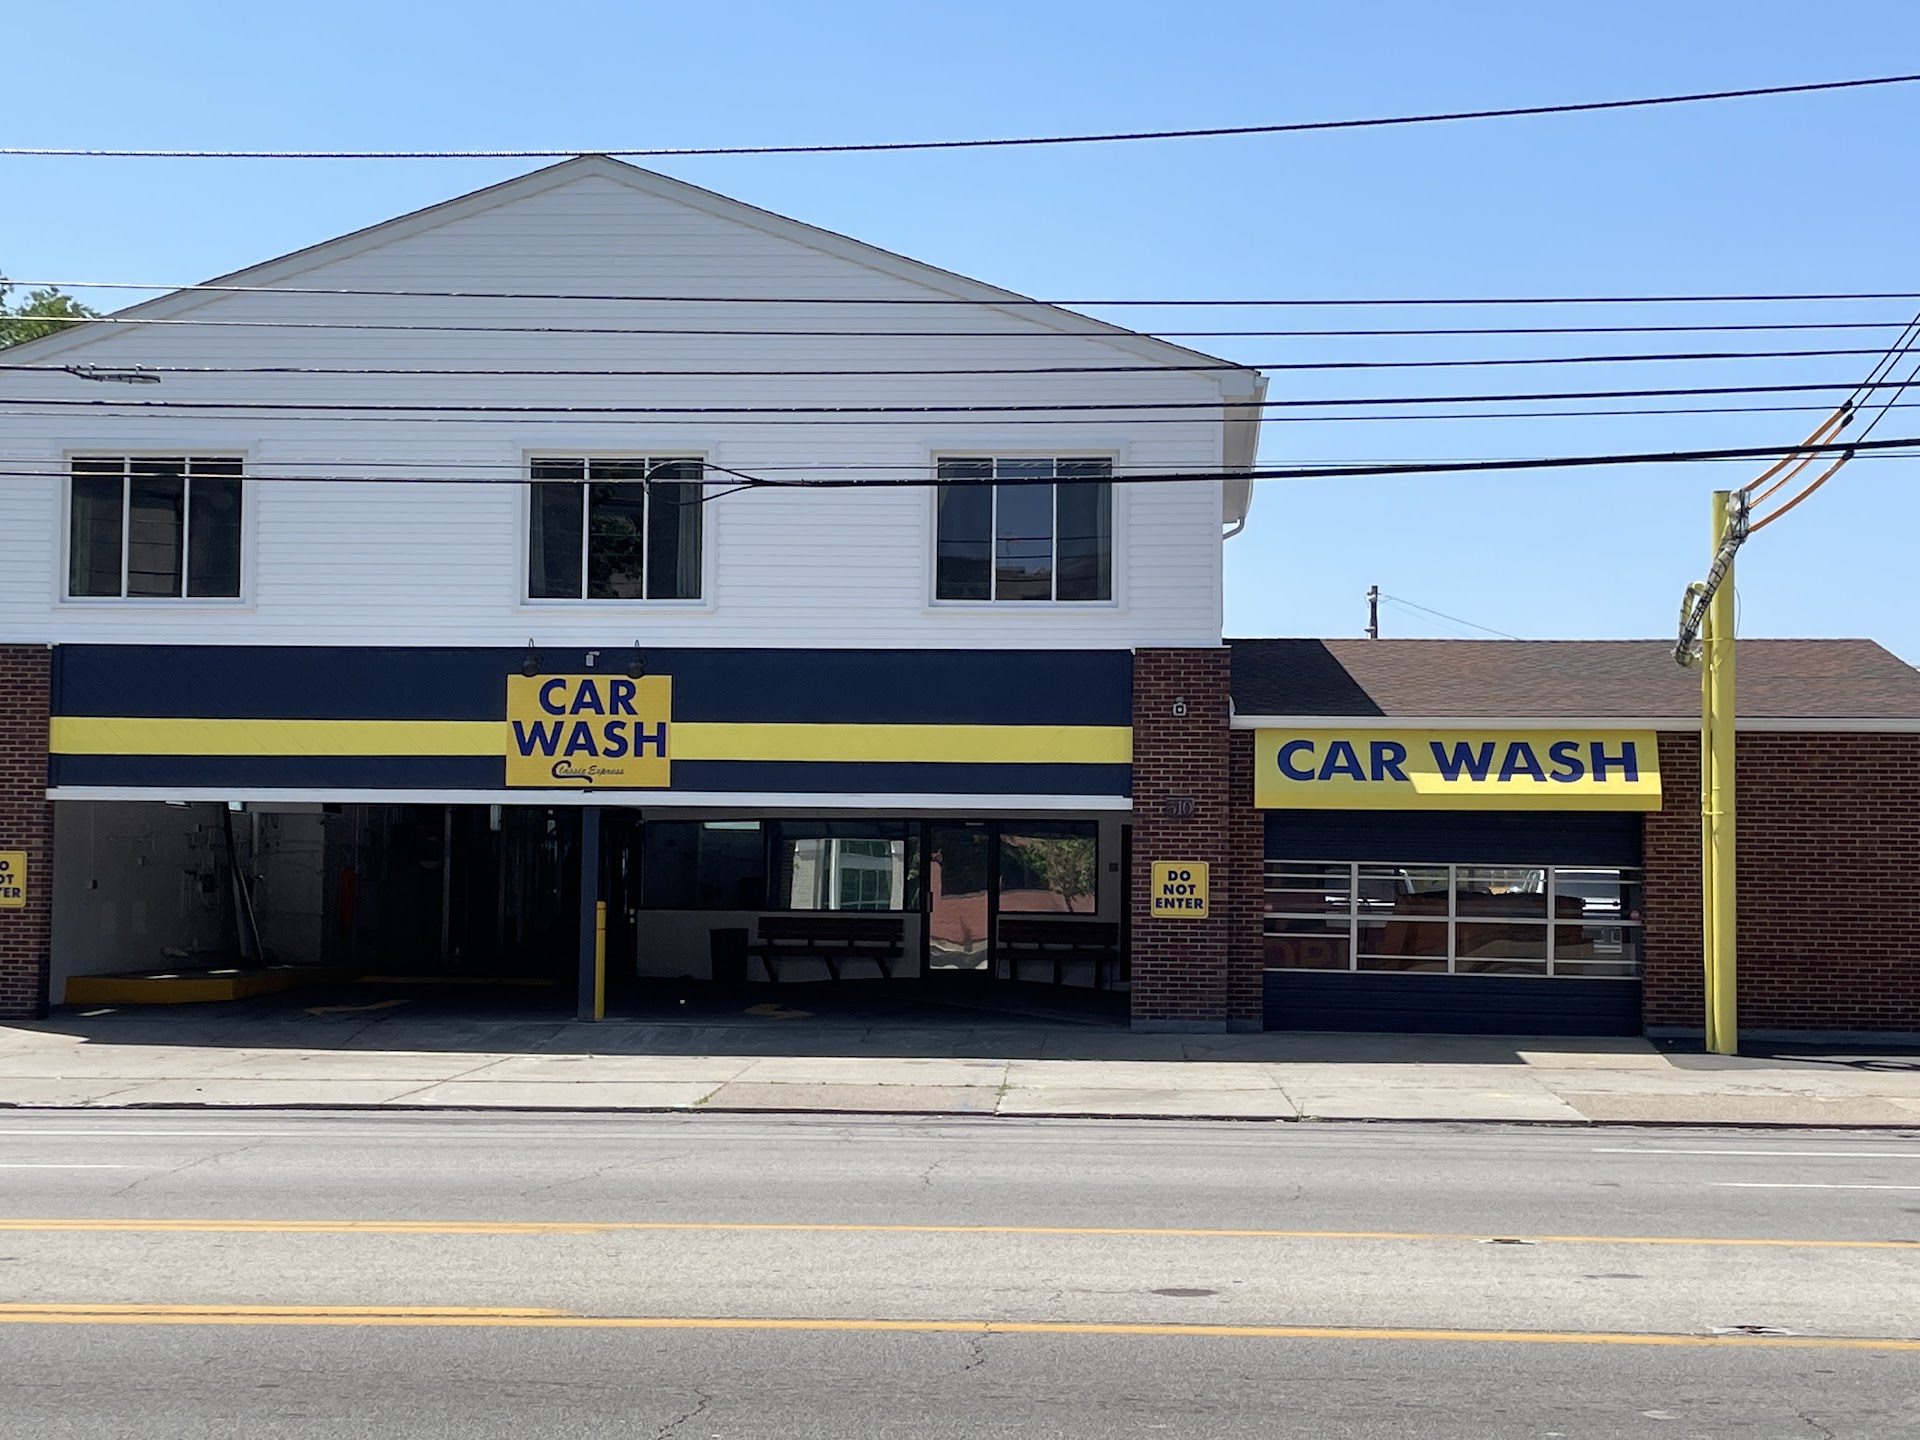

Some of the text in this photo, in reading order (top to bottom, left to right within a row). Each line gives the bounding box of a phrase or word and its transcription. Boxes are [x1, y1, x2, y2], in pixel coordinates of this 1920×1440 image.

[539, 678, 638, 715] CAR
[512, 720, 667, 757] WASH
[1277, 739, 1639, 782] CAR WASH
[552, 760, 624, 783] Classic Express
[1167, 801, 1193, 816] 510
[0, 861, 9, 871] O
[1168, 870, 1191, 881] DO
[1163, 884, 1196, 895] NOT
[1155, 897, 1203, 909] ENTER
